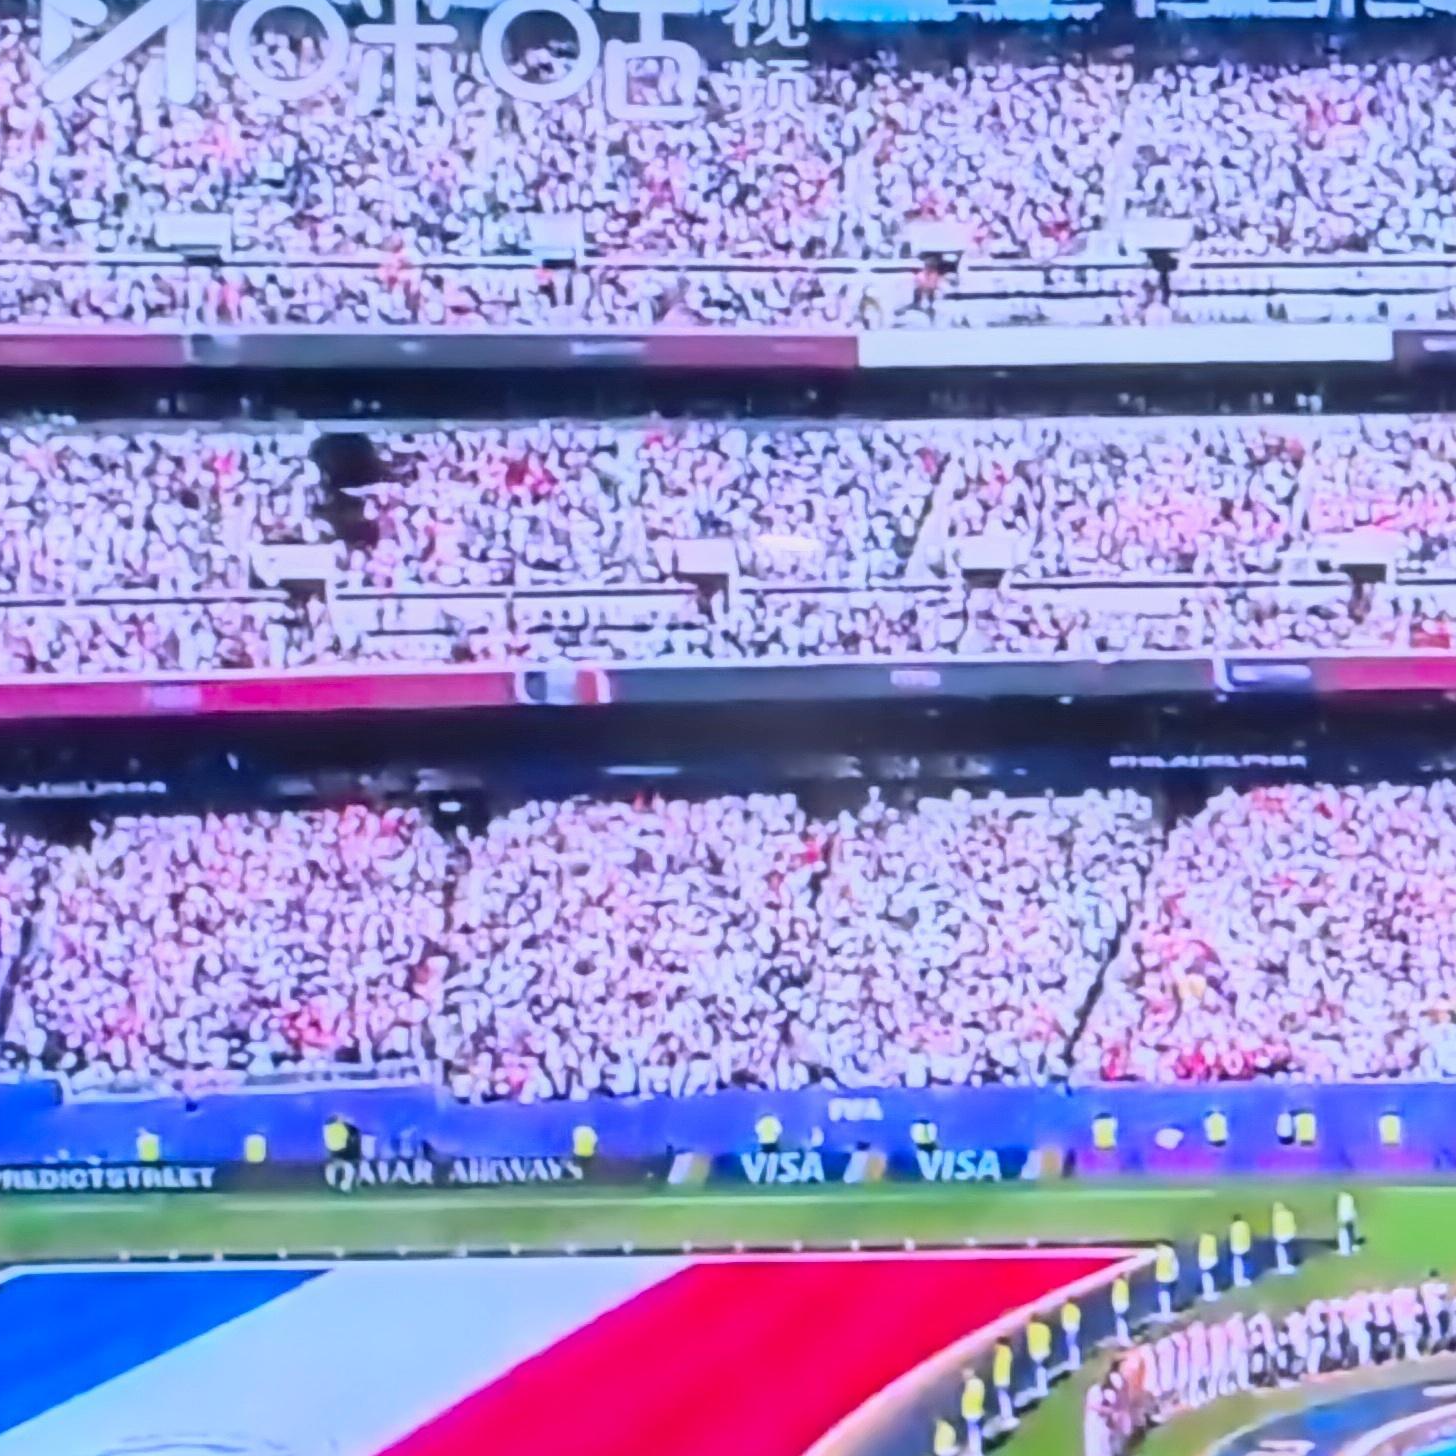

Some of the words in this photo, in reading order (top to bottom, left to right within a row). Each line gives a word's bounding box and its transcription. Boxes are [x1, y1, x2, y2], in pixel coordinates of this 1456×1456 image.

[325, 1159, 433, 1191] QATAR
[741, 1151, 825, 1184] VISA
[915, 1149, 1002, 1182] VISA
